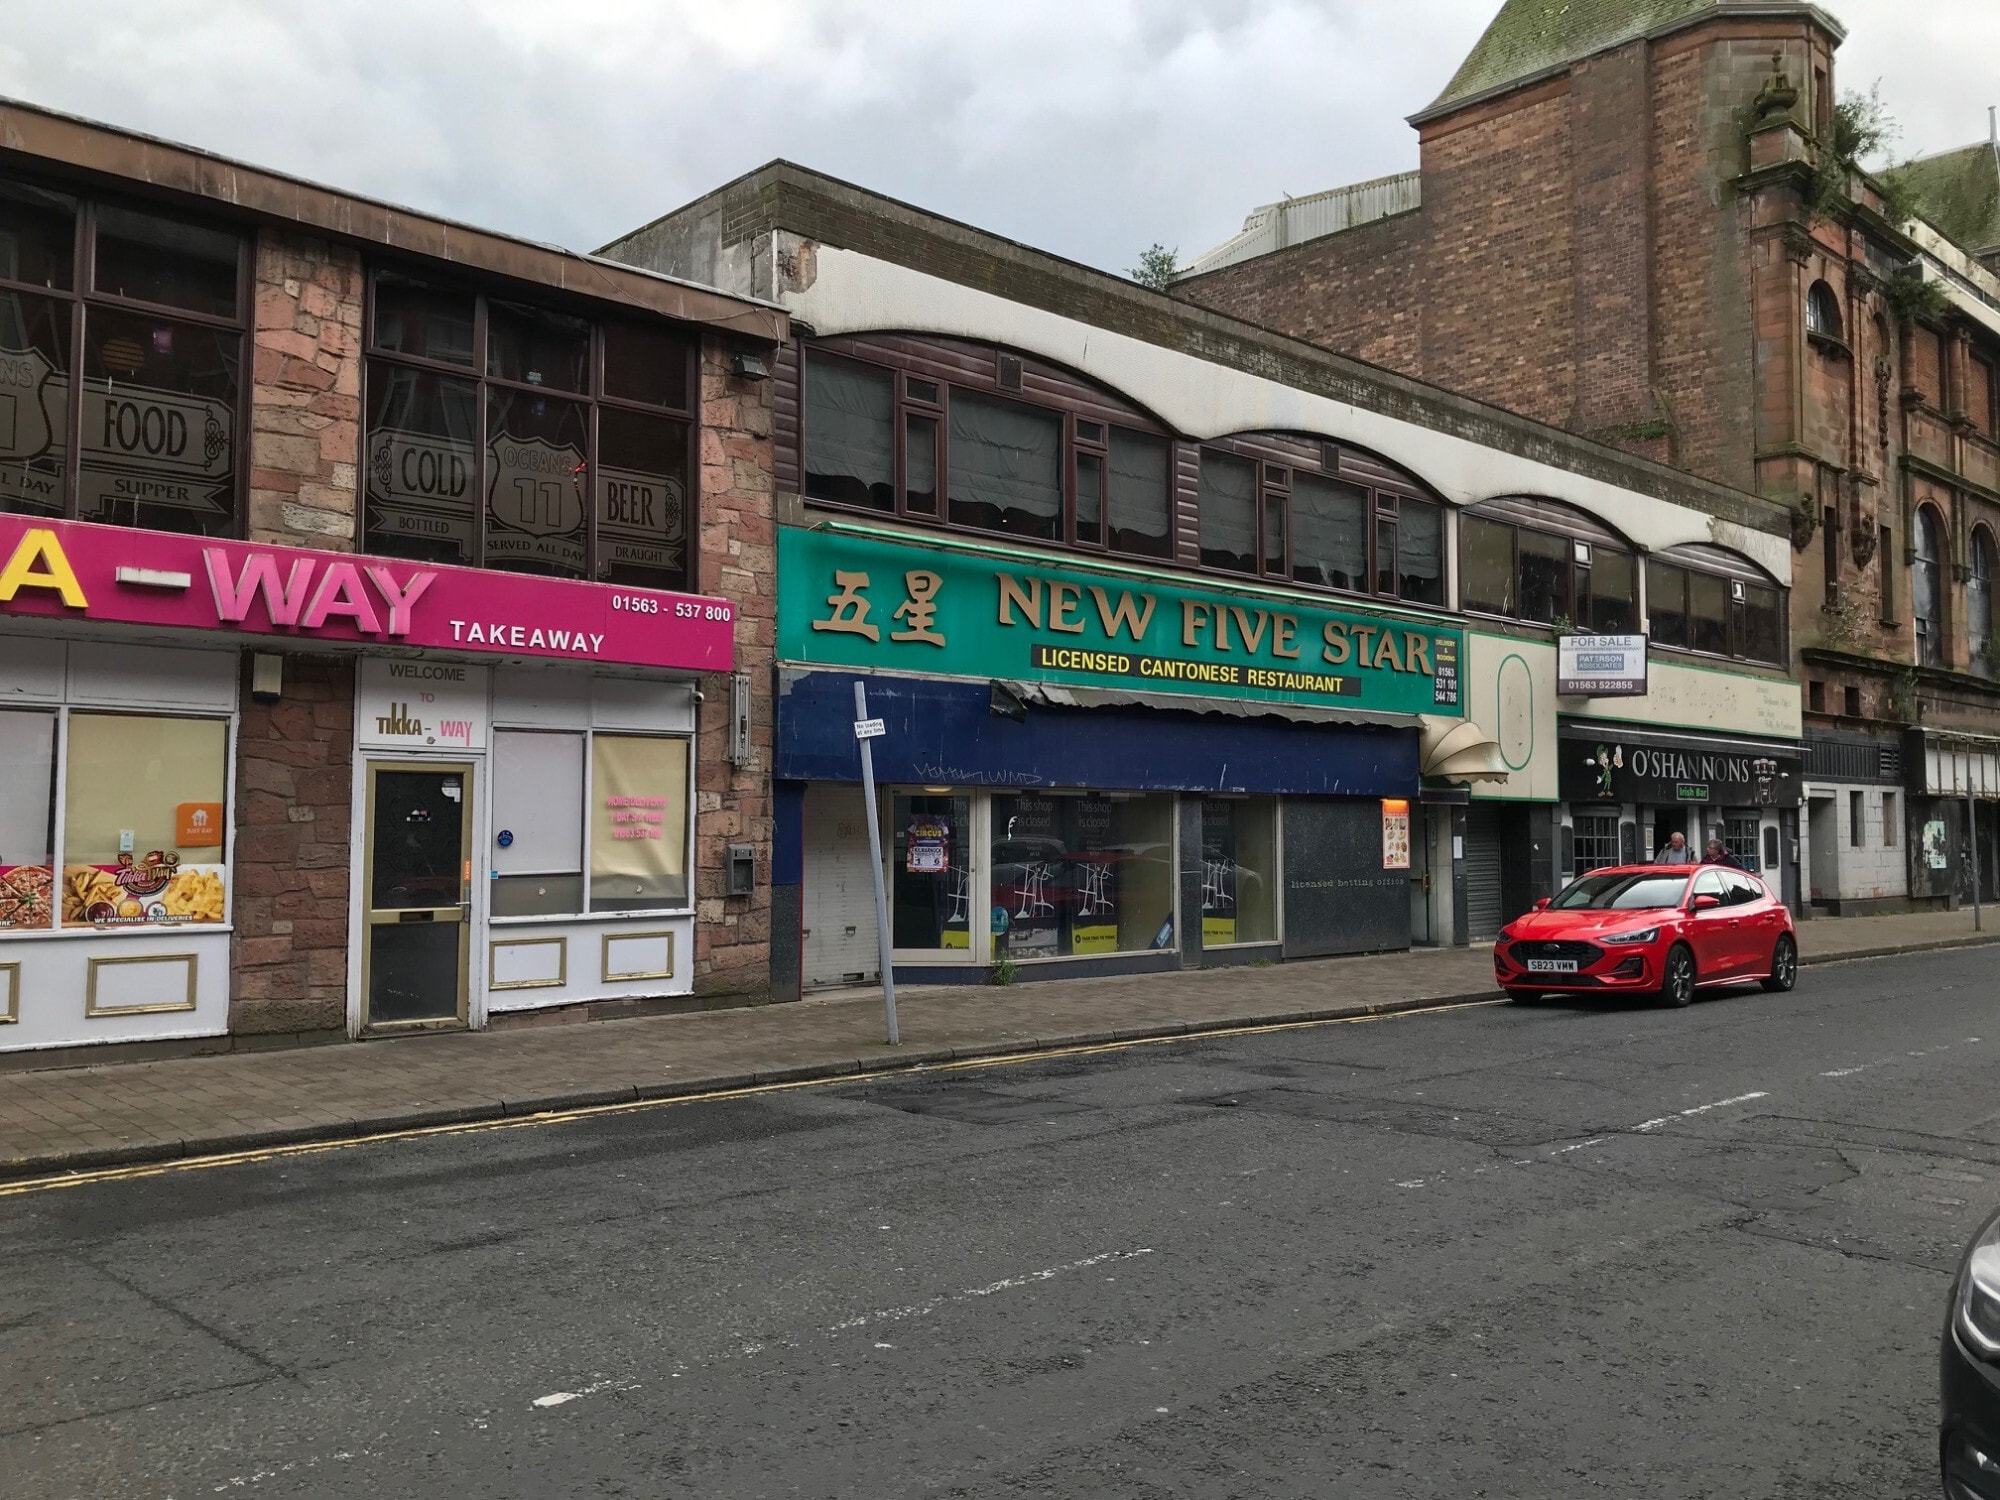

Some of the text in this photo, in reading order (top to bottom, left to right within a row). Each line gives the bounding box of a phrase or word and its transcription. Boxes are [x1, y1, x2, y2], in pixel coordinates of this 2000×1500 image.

[103, 399, 188, 457] FOOD
[503, 445, 572, 477] OCEANS
[401, 447, 467, 497] COLD
[19, 477, 56, 495] DAY
[113, 478, 189, 501] SUPPER
[513, 477, 562, 527] 11
[607, 481, 655, 527] BEER
[399, 516, 450, 534] BOTTLED
[486, 539, 585, 562] SERVED ALL DAY
[615, 546, 664, 563] DRAUGHT
[203, 548, 438, 636] WAY
[612, 595, 659, 615] 01563
[675, 602, 701, 619] 537
[705, 606, 731, 622] 800
[812, 568, 946, 647] 五星
[994, 572, 1434, 676] NEW FIVE STAR
[450, 620, 605, 654] TAKEAWAY
[1570, 636, 1632, 647] FOR SALE
[1579, 655, 1622, 663] PATERSON
[389, 664, 466, 682] WELCOME
[1041, 648, 1343, 693] LICENSED CANTONESE RESTAURANT
[1438, 666, 1455, 677] 01563
[1568, 680, 1633, 690] 01563 522855
[419, 691, 435, 703] TO
[440, 719, 473, 747] WAY
[1632, 749, 1750, 783] O'SHANNONS
[1679, 787, 1707, 797] Irish Bar
[1015, 798, 1053, 814] This shop
[1076, 800, 1112, 814] This shop
[1026, 815, 1051, 827] closed
[1087, 816, 1110, 828] closed
[915, 829, 943, 837] CIRCUS
[1291, 878, 1405, 889] licensed betting office
[107, 916, 147, 924] SPECIALISE
[1531, 960, 1555, 971] SB23
